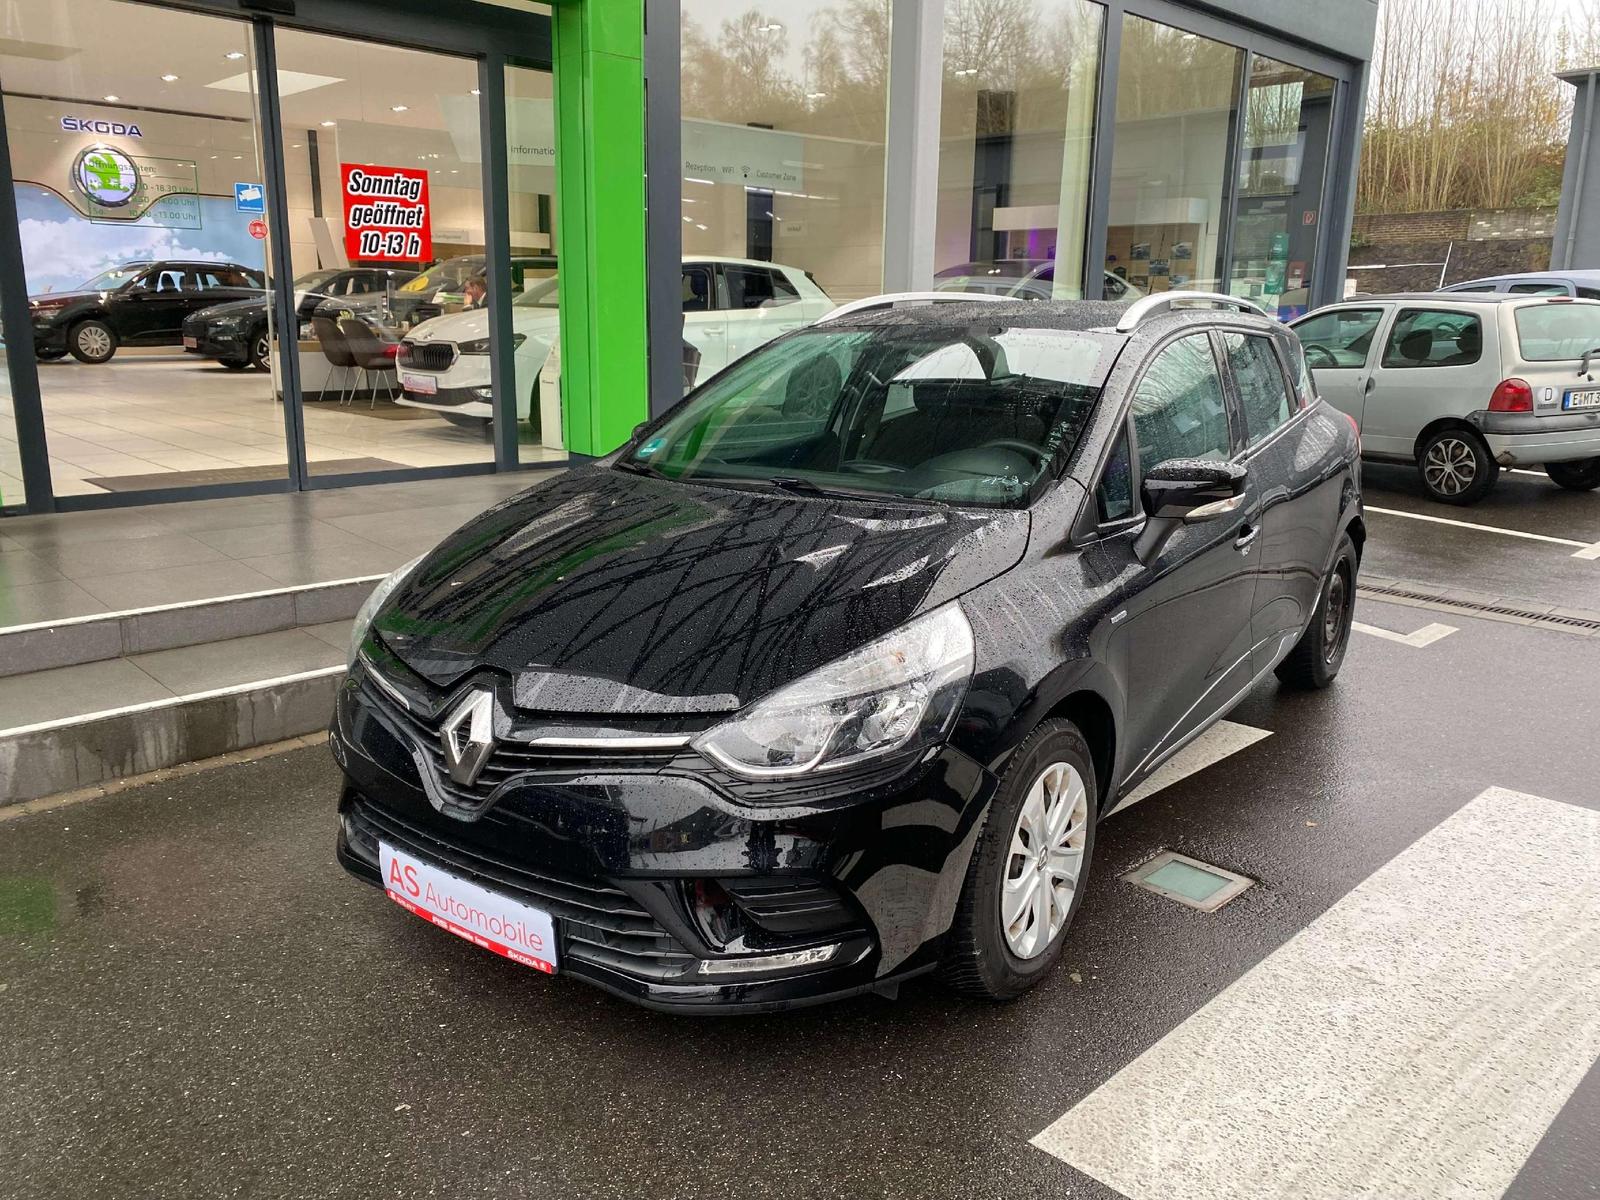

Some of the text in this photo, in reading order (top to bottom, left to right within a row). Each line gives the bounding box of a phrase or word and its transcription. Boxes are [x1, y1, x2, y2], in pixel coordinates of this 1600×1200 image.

[62, 115, 142, 137] ŠKODA
[686, 160, 716, 173] Rezeption
[756, 170, 782, 180] Customer
[783, 172, 797, 181] Zone
[349, 171, 421, 200] Sonntag
[351, 203, 423, 227] geöffnet
[361, 233, 420, 255] 10-13 h
[1545, 388, 1553, 401] D
[389, 858, 420, 897] AS
[425, 882, 544, 951] Automobile
